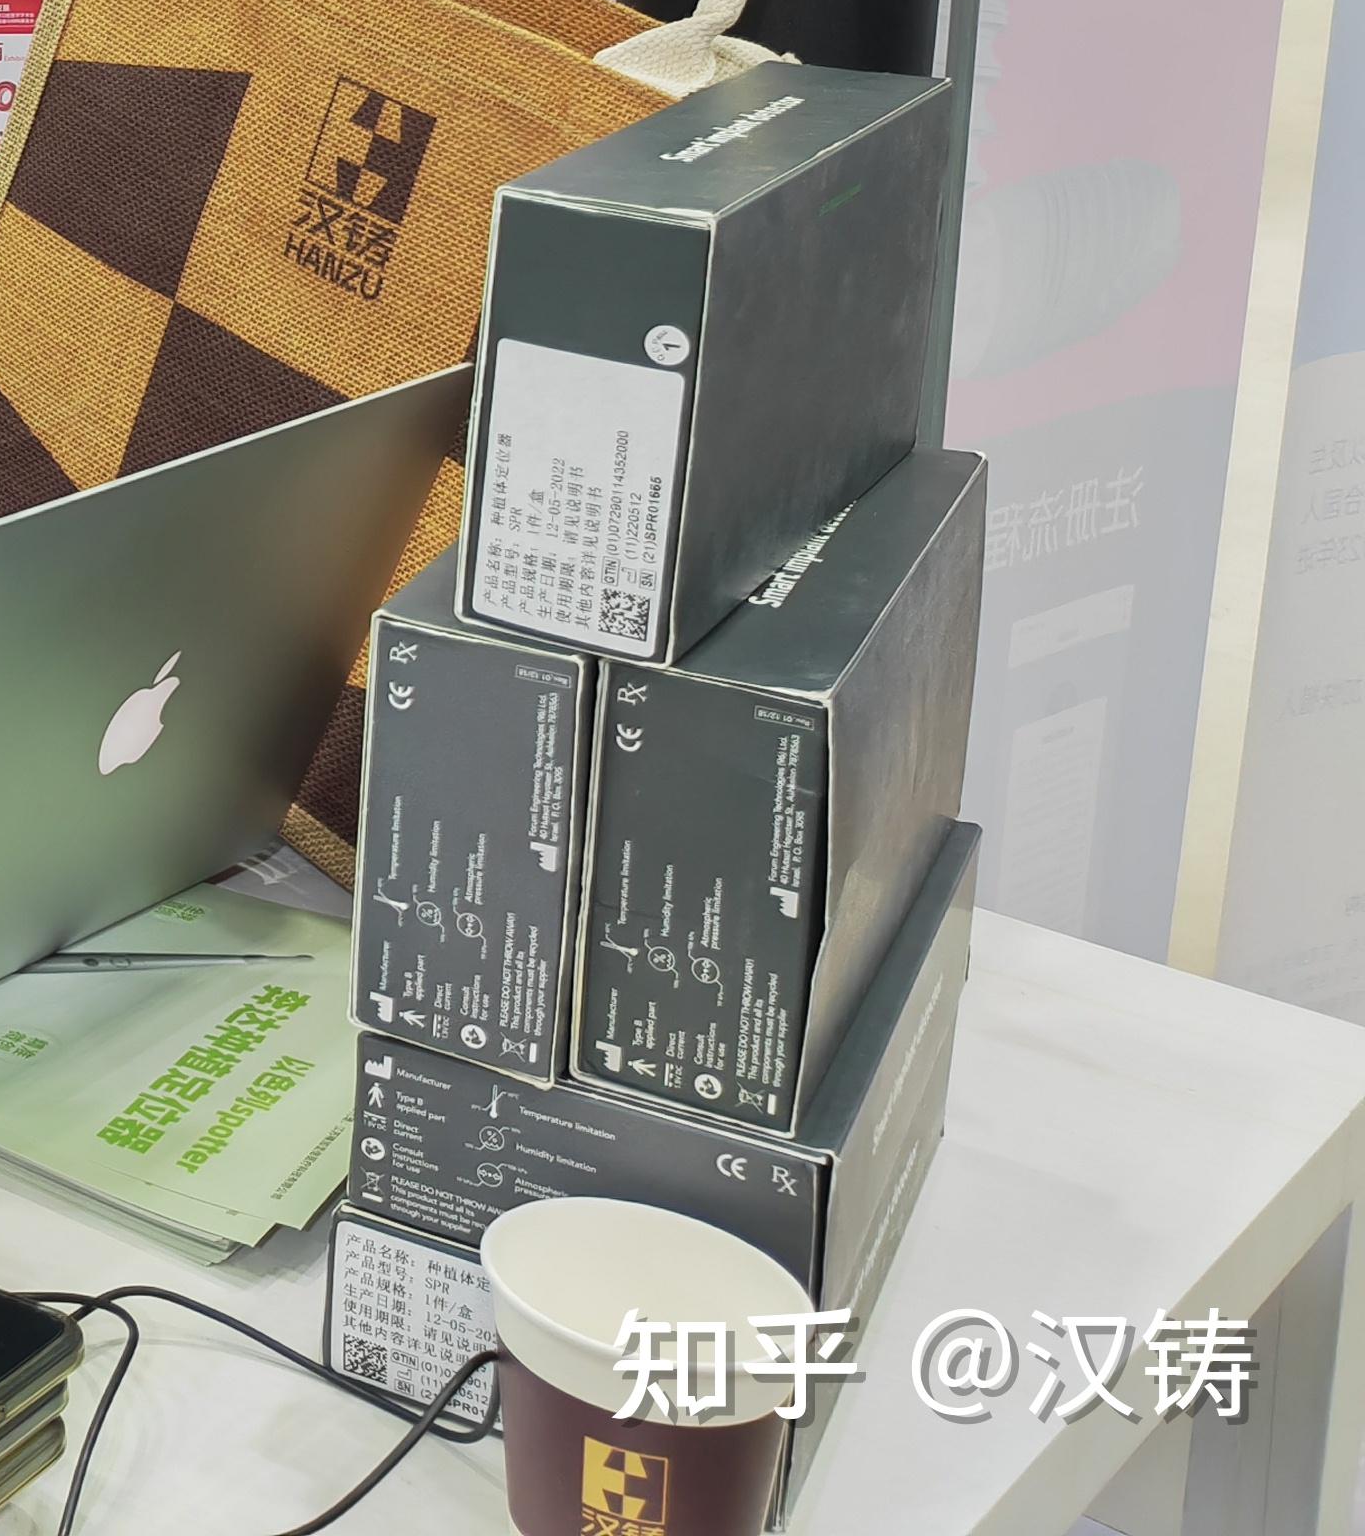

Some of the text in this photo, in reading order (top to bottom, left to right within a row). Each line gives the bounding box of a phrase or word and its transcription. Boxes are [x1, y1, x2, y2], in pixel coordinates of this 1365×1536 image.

[283, 235, 388, 302] HANZU
[545, 456, 567, 539] 12-05-2022
[508, 506, 523, 533] SPR
[603, 558, 618, 585] GTIN
[640, 570, 655, 591] SN
[748, 571, 802, 609] Smart
[395, 1066, 453, 1092] Manufacturer
[176, 1054, 316, 1175] 以色列spotter
[519, 1105, 617, 1142] Temperature limitation
[515, 1142, 597, 1175] Humidity limitation
[424, 1277, 451, 1296] SPR
[391, 1349, 419, 1369] GTIN
[396, 1380, 413, 1395] SN
